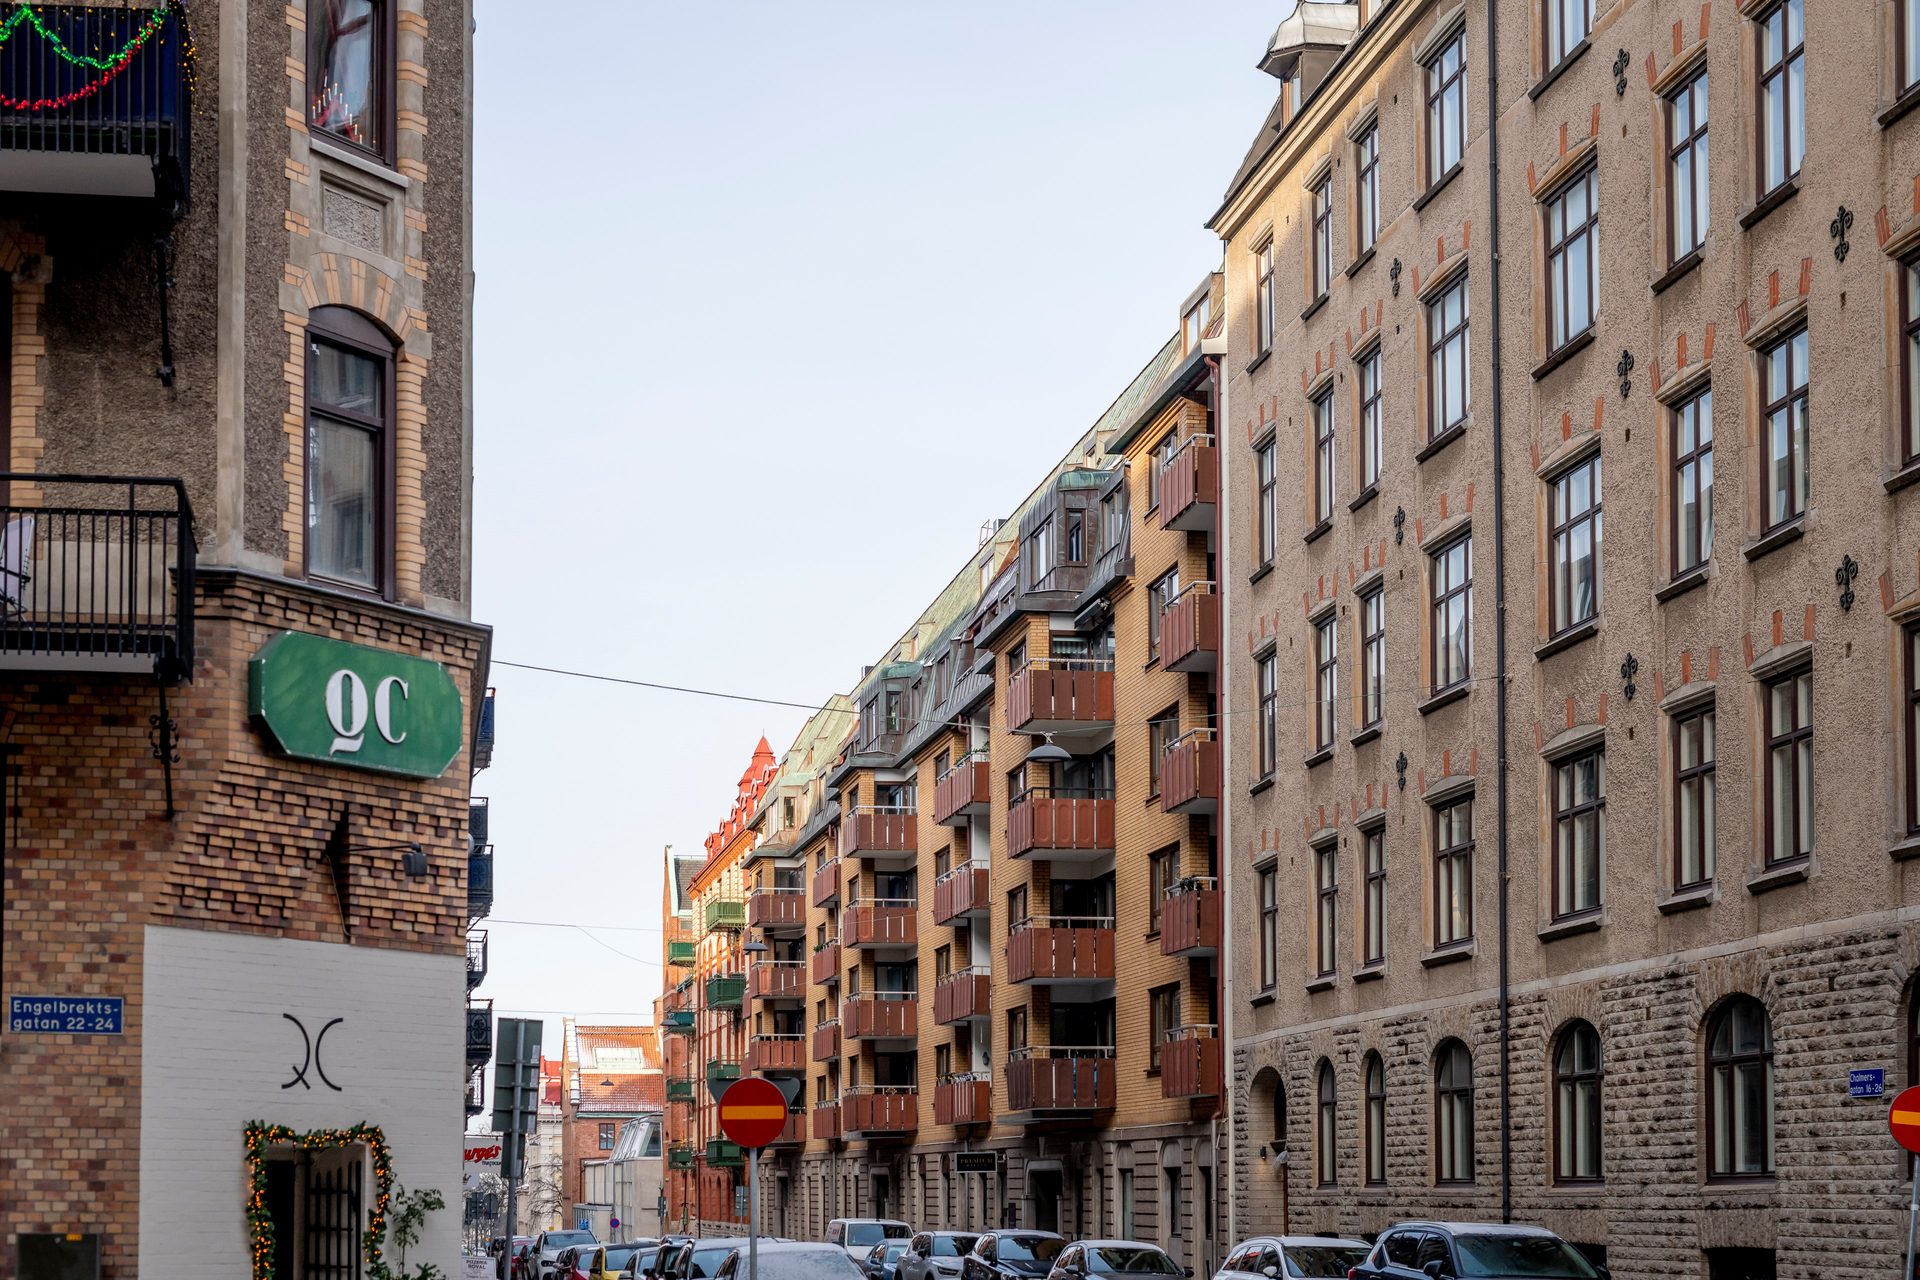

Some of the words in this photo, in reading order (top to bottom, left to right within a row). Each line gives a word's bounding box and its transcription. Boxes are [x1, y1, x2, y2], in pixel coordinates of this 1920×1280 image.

[325, 668, 409, 757] QC
[13, 1000, 119, 1016] Engelbrekts-
[13, 1017, 60, 1032] gatan
[66, 1017, 114, 1030] 22-24
[1849, 1085, 1864, 1096] gatan
